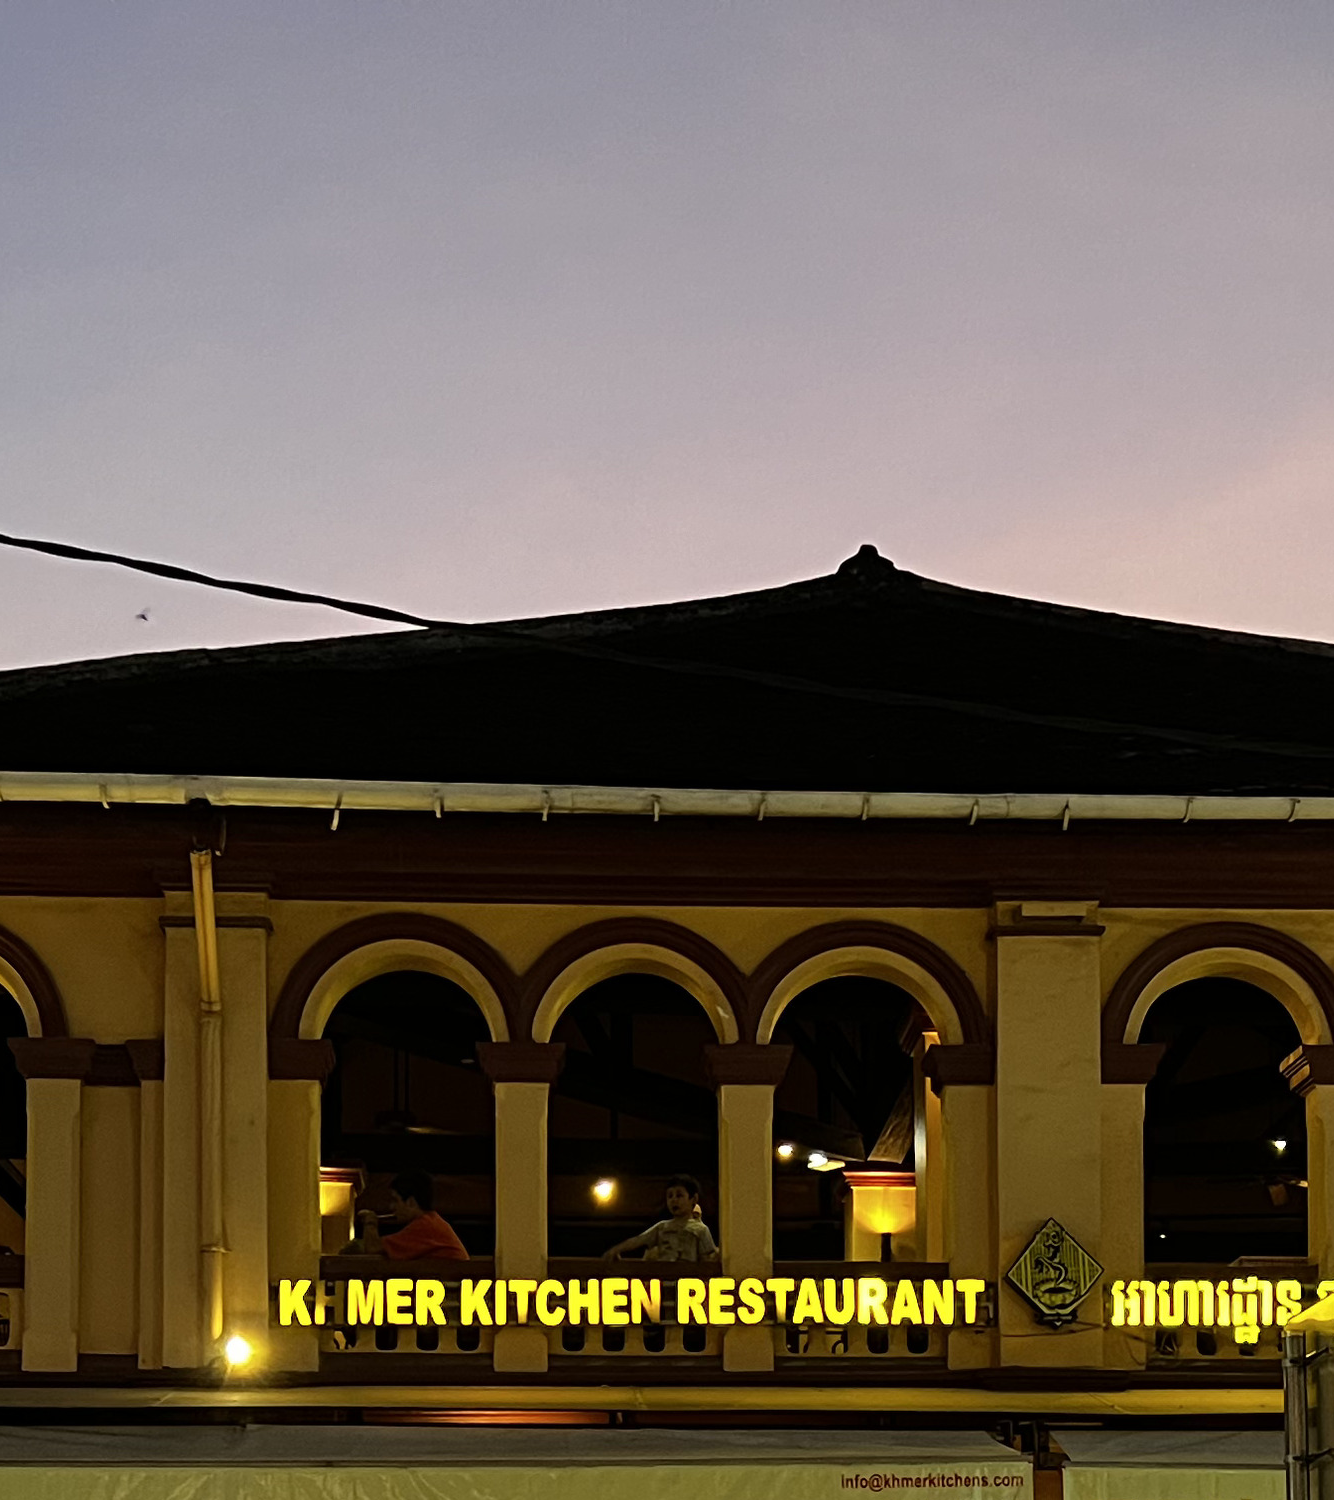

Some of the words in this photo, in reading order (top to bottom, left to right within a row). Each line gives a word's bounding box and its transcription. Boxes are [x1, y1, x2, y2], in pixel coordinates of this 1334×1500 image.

[461, 1278, 662, 1326] KITCHEN
[677, 1277, 986, 1326] RESTAURANT
[841, 1473, 1024, 1490] info@khmerkitchens.com
